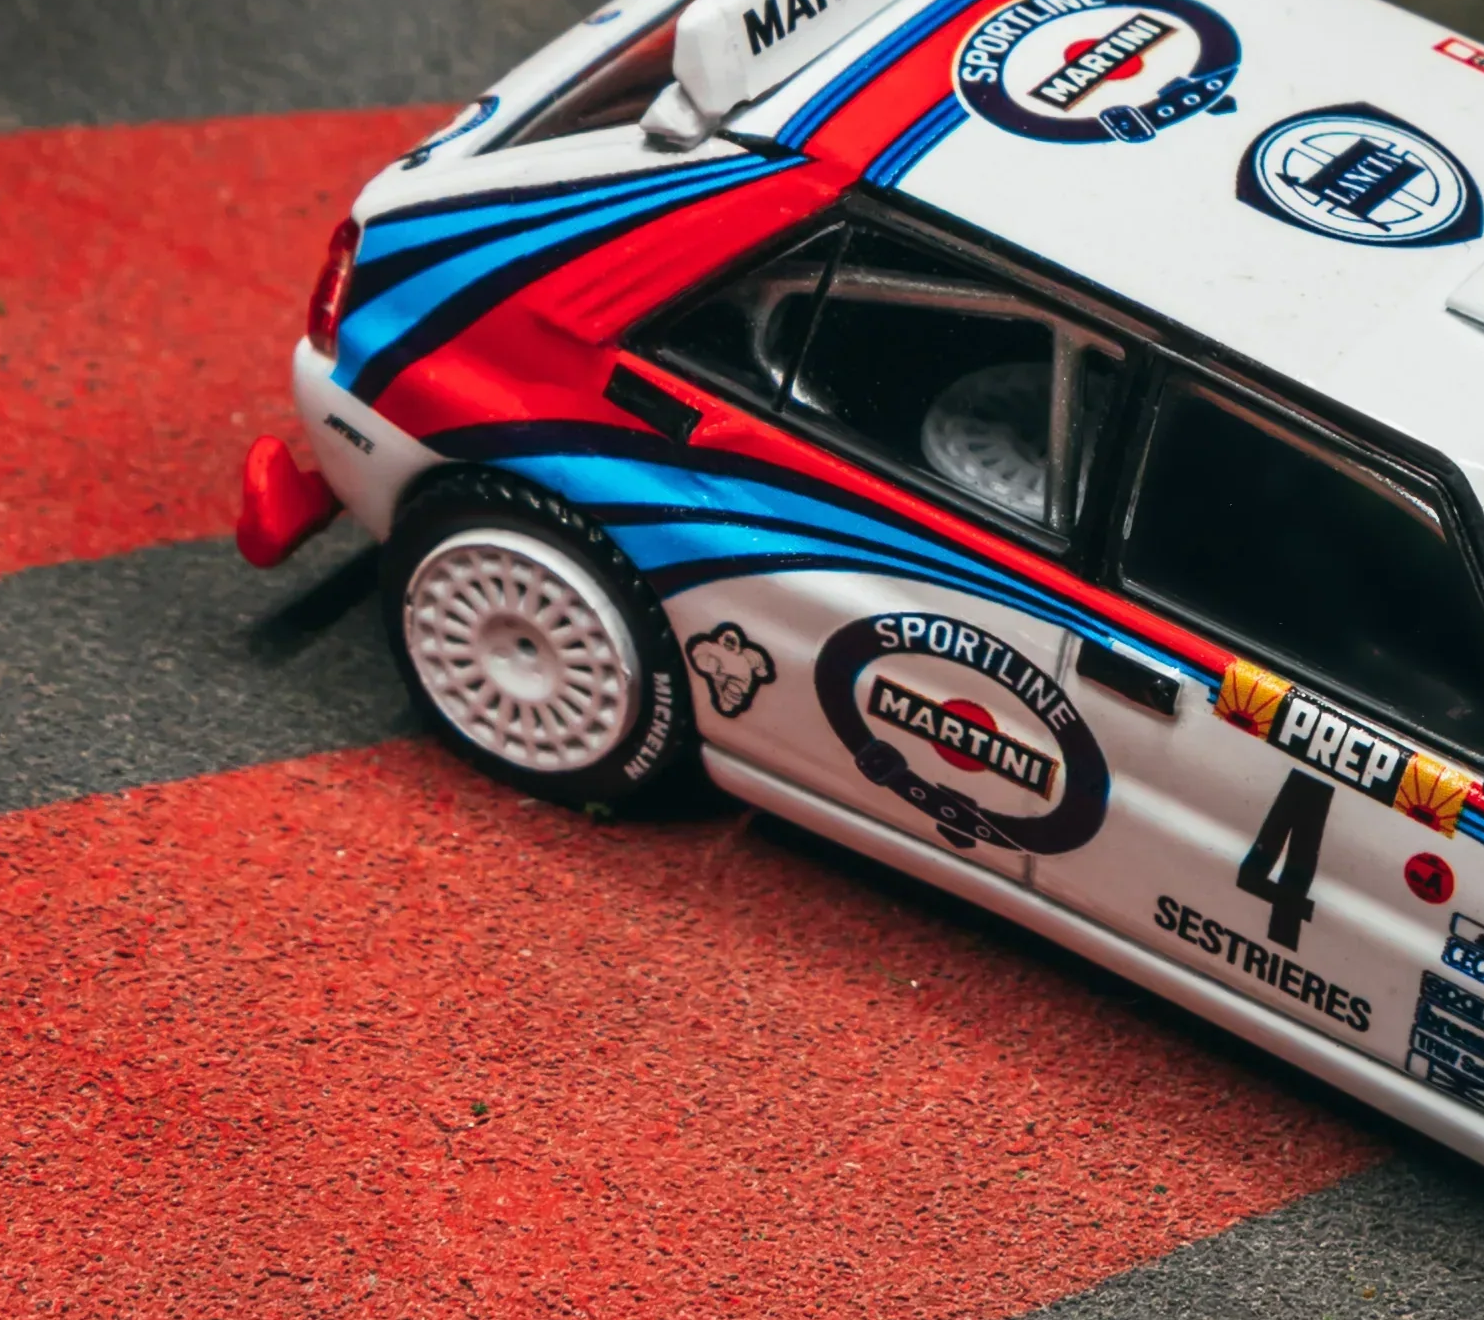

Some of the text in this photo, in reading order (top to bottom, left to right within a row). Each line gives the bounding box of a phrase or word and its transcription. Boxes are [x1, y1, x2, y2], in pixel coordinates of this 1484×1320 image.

[1041, 18, 1163, 103] MARTINI
[622, 672, 673, 780] MICHELIN
[874, 616, 1077, 731] SPORTLINE
[879, 687, 1045, 785] MARTINI
[1277, 696, 1400, 789] PREP
[1235, 767, 1336, 952] 4
[1153, 894, 1372, 1033] SESTRIERES
